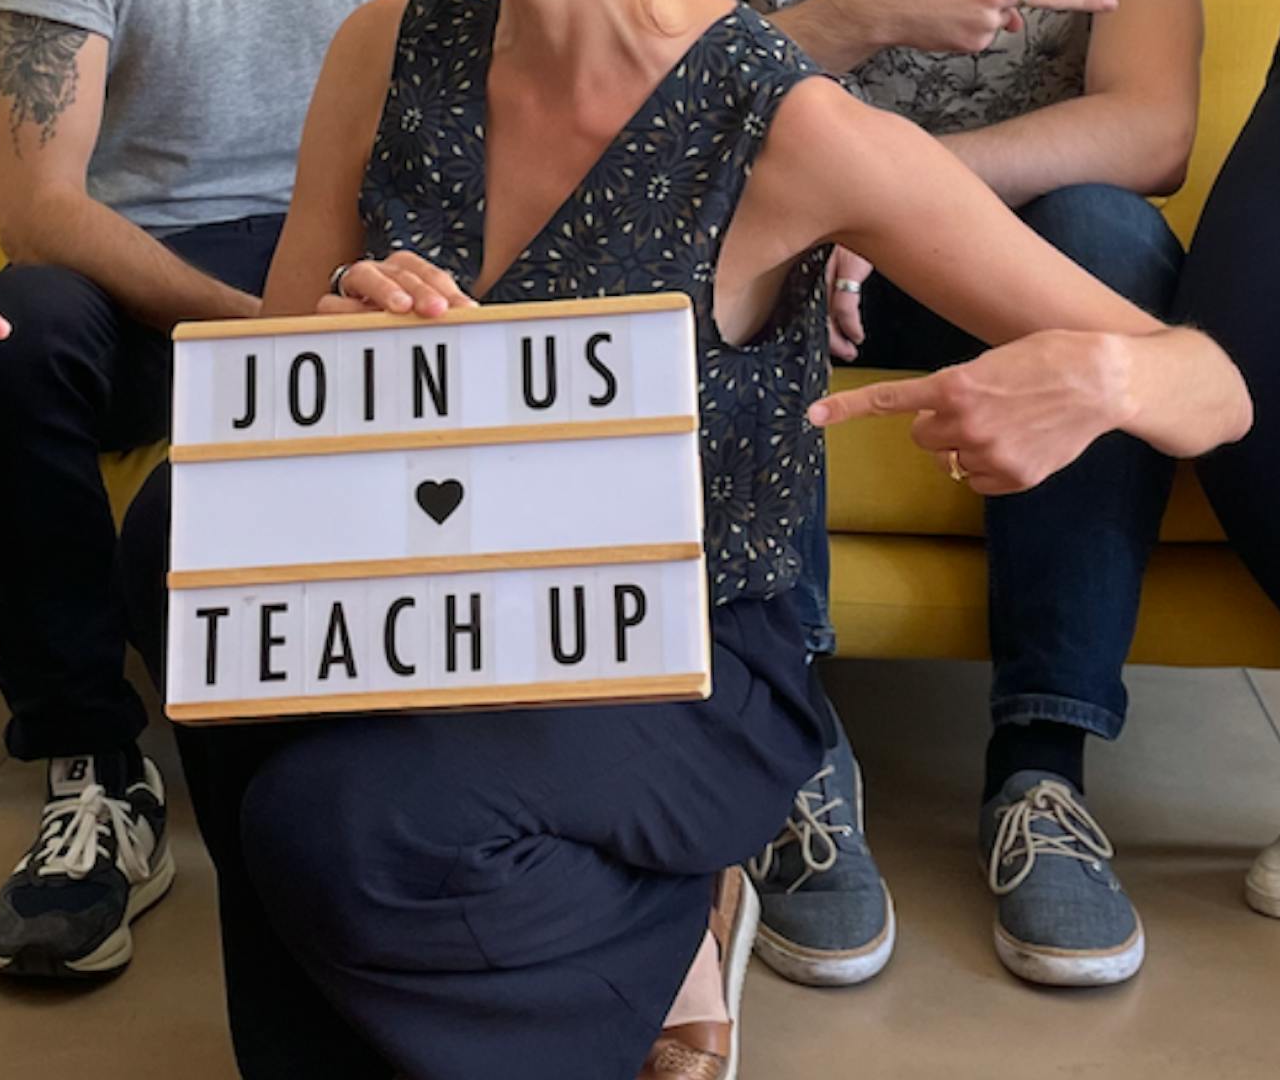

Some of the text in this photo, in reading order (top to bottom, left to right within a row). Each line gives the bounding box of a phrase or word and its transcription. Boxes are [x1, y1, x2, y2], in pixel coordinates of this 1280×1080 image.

[232, 332, 618, 430] JOIN US
[195, 584, 648, 686] TEACH UP
